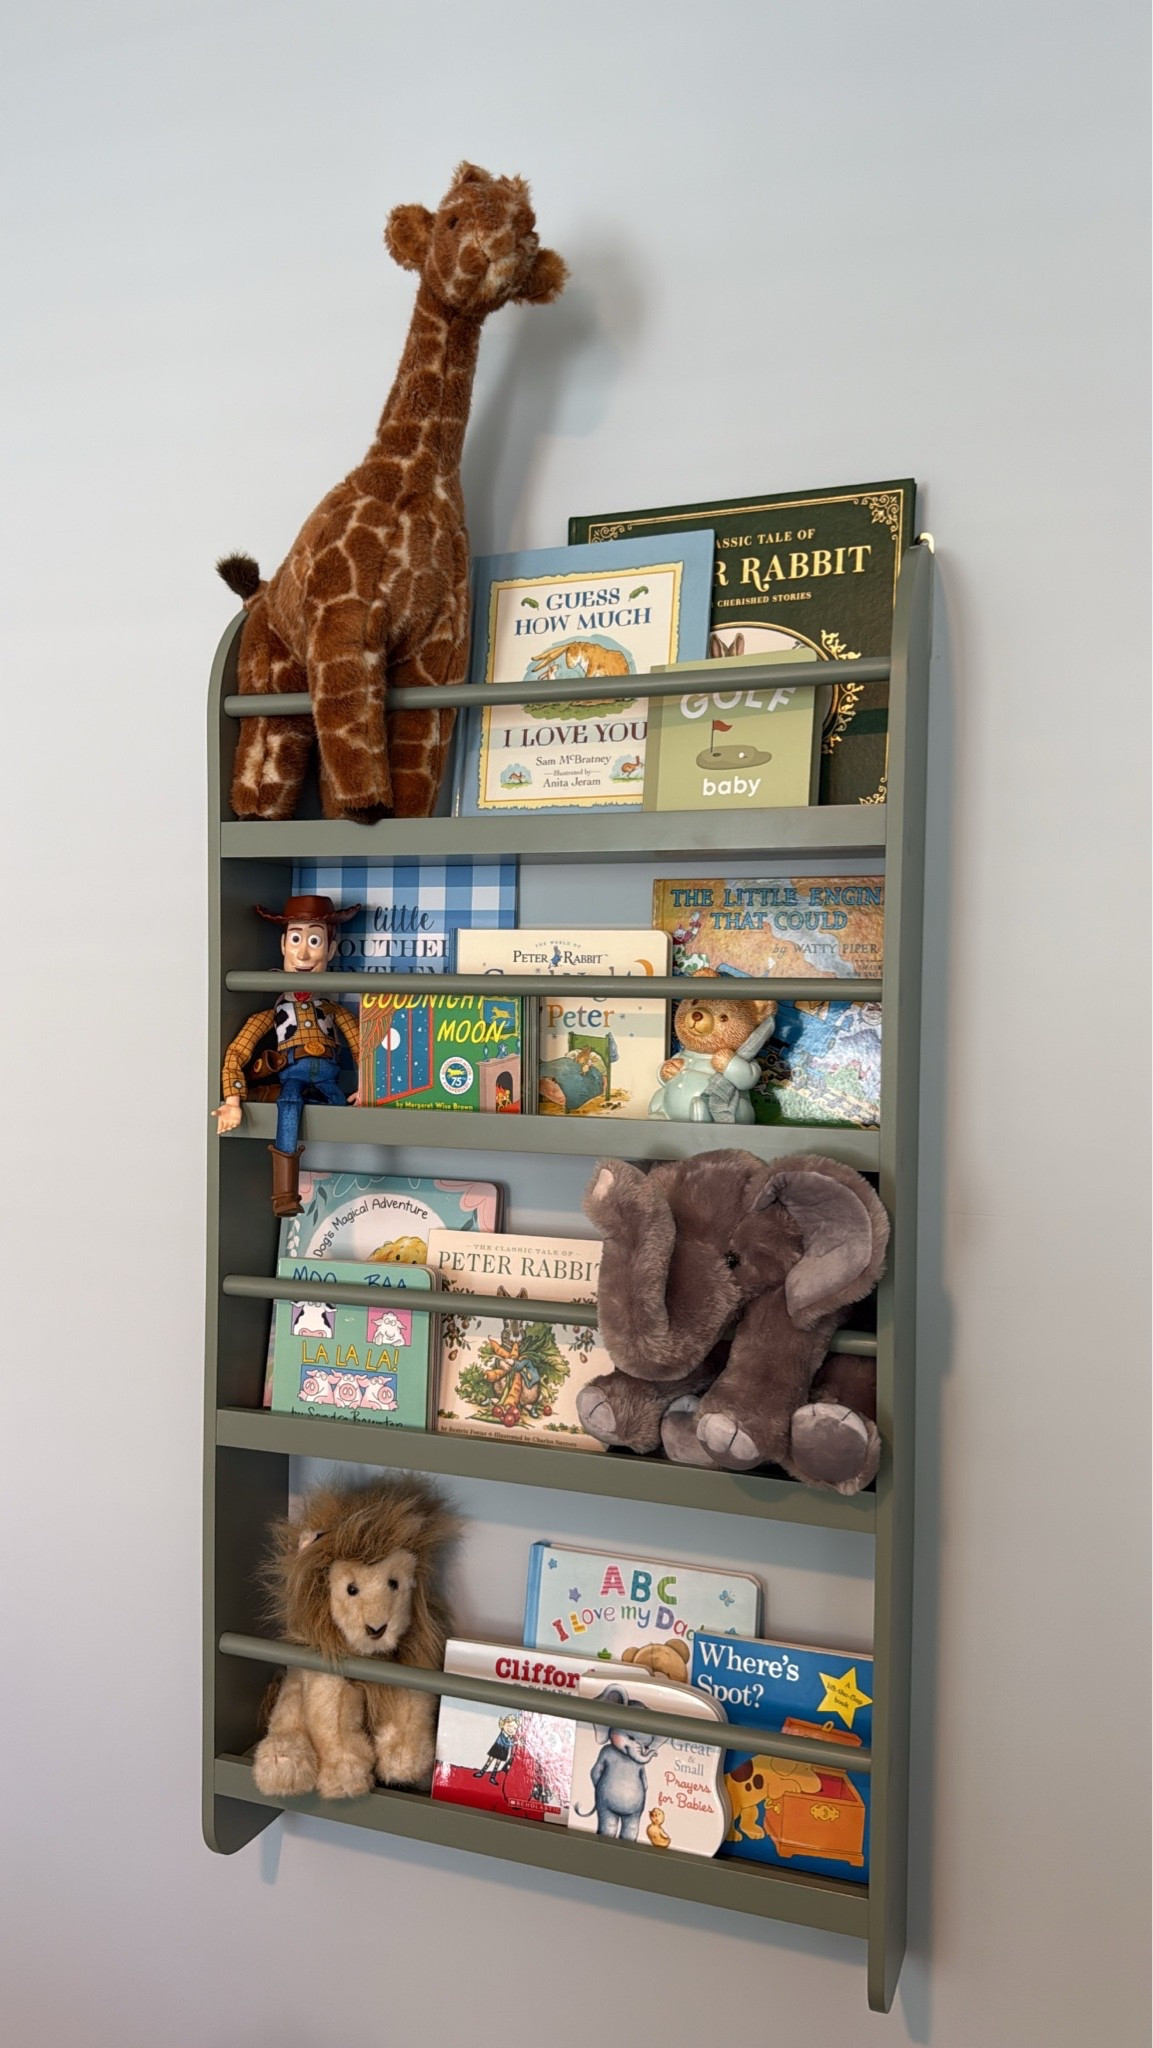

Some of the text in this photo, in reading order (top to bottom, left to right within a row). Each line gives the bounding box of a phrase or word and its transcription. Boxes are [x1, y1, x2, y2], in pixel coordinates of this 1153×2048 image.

[758, 531, 793, 544] TALE
[797, 529, 816, 540] OF
[740, 544, 872, 592] RABBIT
[546, 587, 620, 611] GUESS
[717, 592, 812, 608] CHERISHED STORIES
[514, 607, 652, 636] HOW MUCH
[503, 721, 648, 748] I LOVE YOU
[535, 754, 612, 766] Sam McBratney
[543, 777, 601, 789] Anita Jeram
[702, 776, 762, 797] baby
[671, 886, 883, 907] THE LITTLE ENGIN
[374, 904, 435, 932] little
[711, 911, 848, 931] THAT COULD
[337, 939, 450, 957] OUTHE
[513, 950, 548, 963] PETER
[772, 943, 879, 958] by WATTY PIPER
[546, 1004, 615, 1028] Peter
[437, 1019, 506, 1043] MOON
[396, 1100, 403, 1108] by
[405, 1101, 433, 1110] Margaret
[435, 1102, 451, 1110] Wise
[313, 1197, 429, 1257] Dog's Magical Adventure
[494, 1245, 533, 1254] CLASSIC
[535, 1248, 558, 1256] TALE
[438, 1251, 512, 1276] PETER
[302, 1340, 399, 1372] LA LA LA!
[600, 1564, 678, 1605] ABC
[552, 1619, 570, 1642] I
[569, 1606, 616, 1635] Love
[621, 1606, 651, 1629] my
[495, 1657, 581, 1689] Cliffor
[699, 1641, 800, 1681] Where's
[697, 1674, 764, 1708] Spot?
[674, 1760, 704, 1777] Small
[664, 1771, 711, 1795] Prayers
[658, 1791, 714, 1813] for Babies
